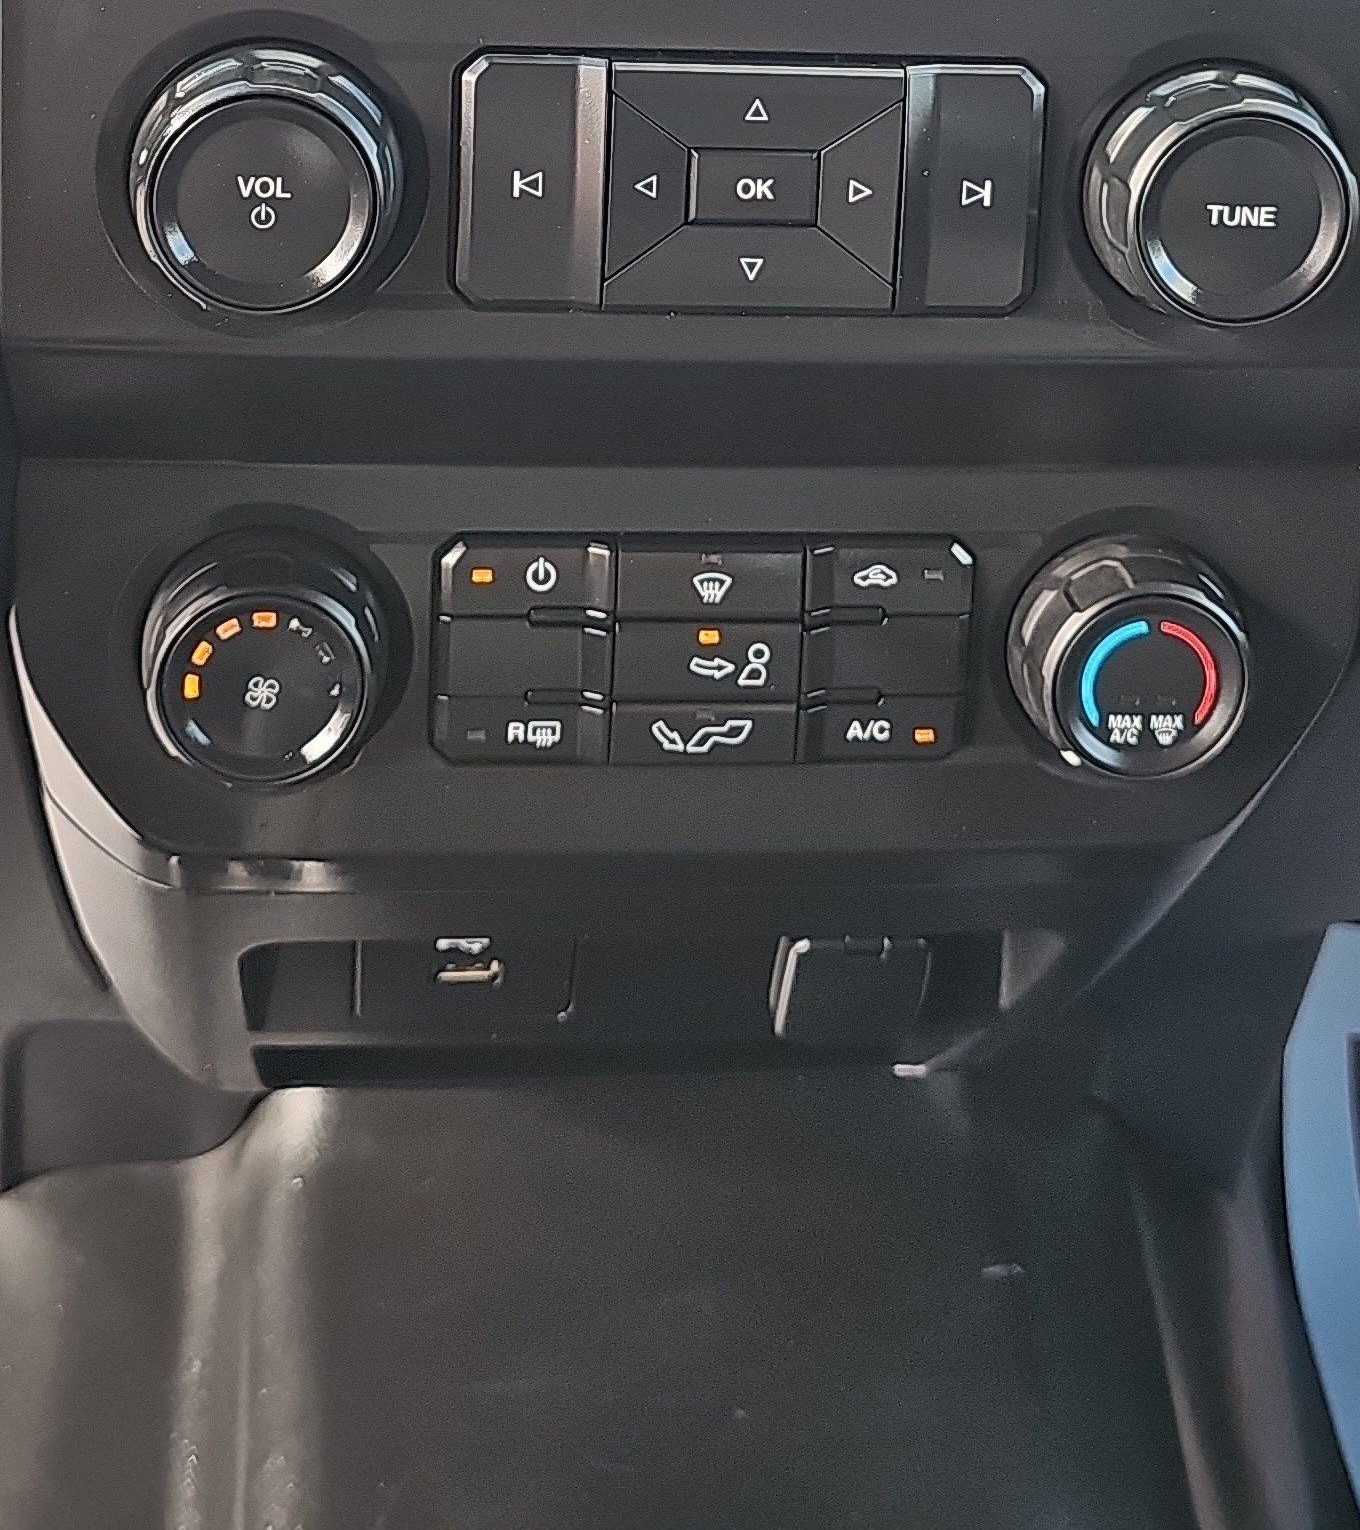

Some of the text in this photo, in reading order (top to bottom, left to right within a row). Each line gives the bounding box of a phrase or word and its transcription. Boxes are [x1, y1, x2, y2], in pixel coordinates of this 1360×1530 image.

[237, 176, 292, 200] VOL
[735, 177, 775, 201] OK
[1206, 203, 1277, 228] TUNE
[845, 719, 892, 743] A/C
[1108, 714, 1143, 730] MAX
[1149, 714, 1184, 730] MAX
[1109, 728, 1140, 746] A/C
